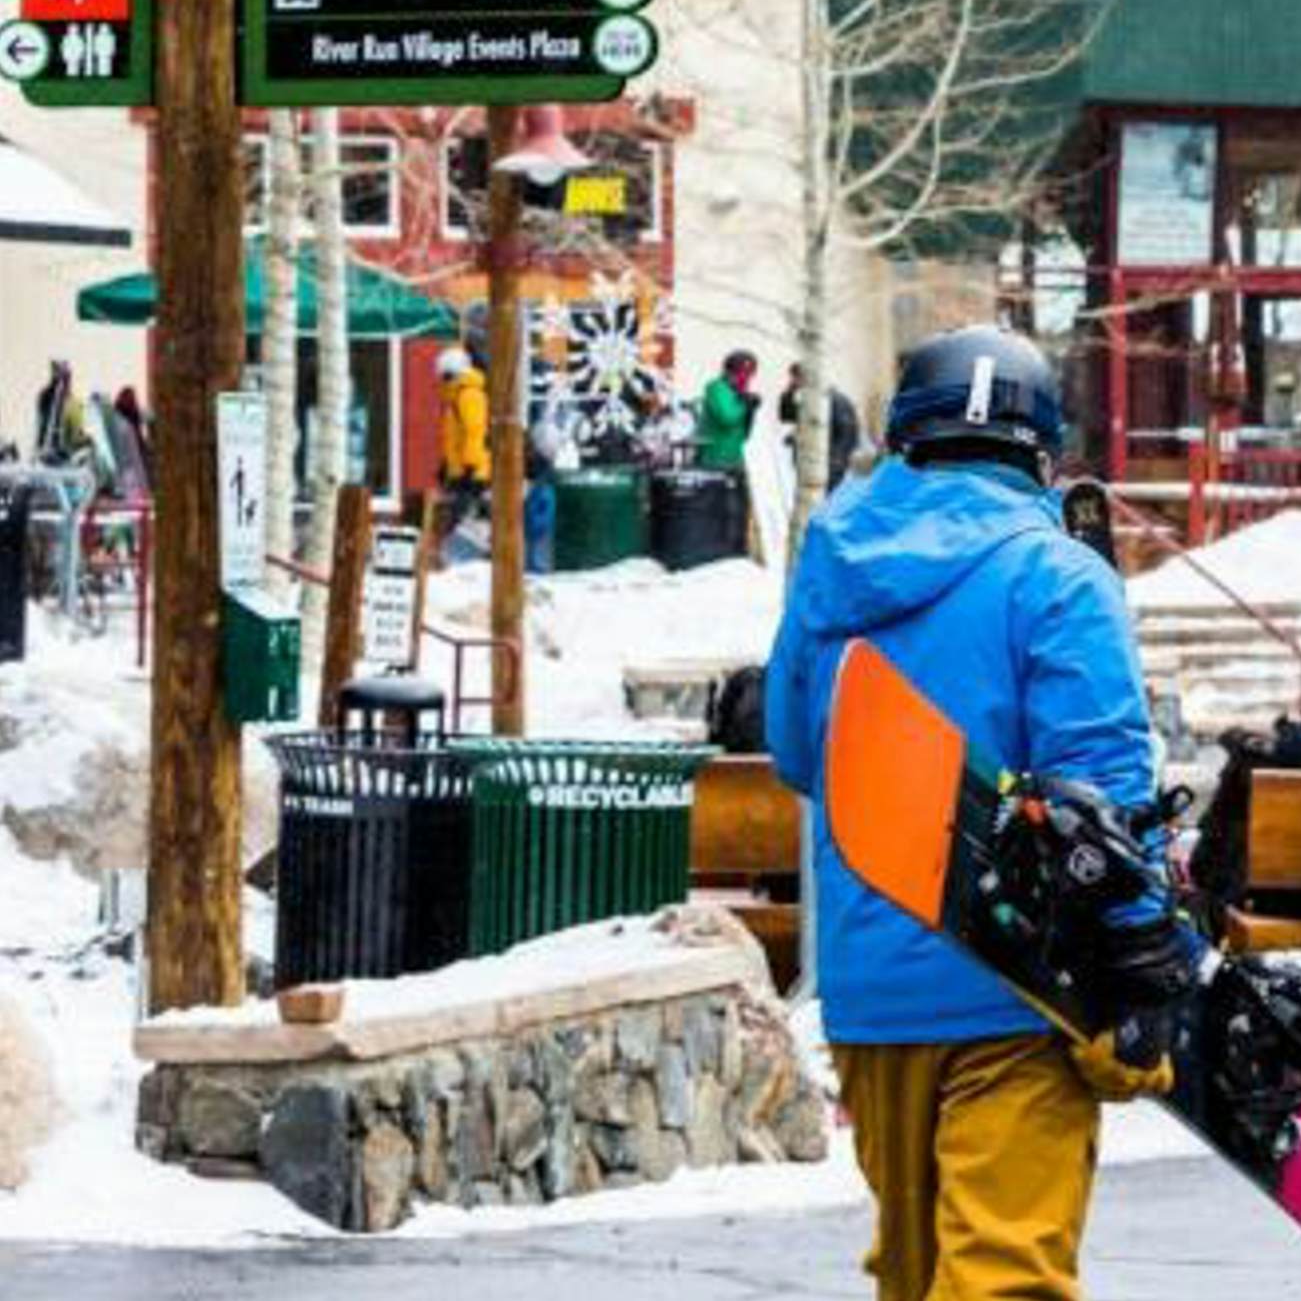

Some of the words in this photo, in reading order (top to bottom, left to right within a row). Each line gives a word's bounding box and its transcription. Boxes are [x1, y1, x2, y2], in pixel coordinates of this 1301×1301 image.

[312, 35, 358, 62] River
[363, 34, 398, 61] Run
[402, 32, 464, 66] Village
[468, 32, 525, 61] Events
[530, 30, 581, 59] Plaza
